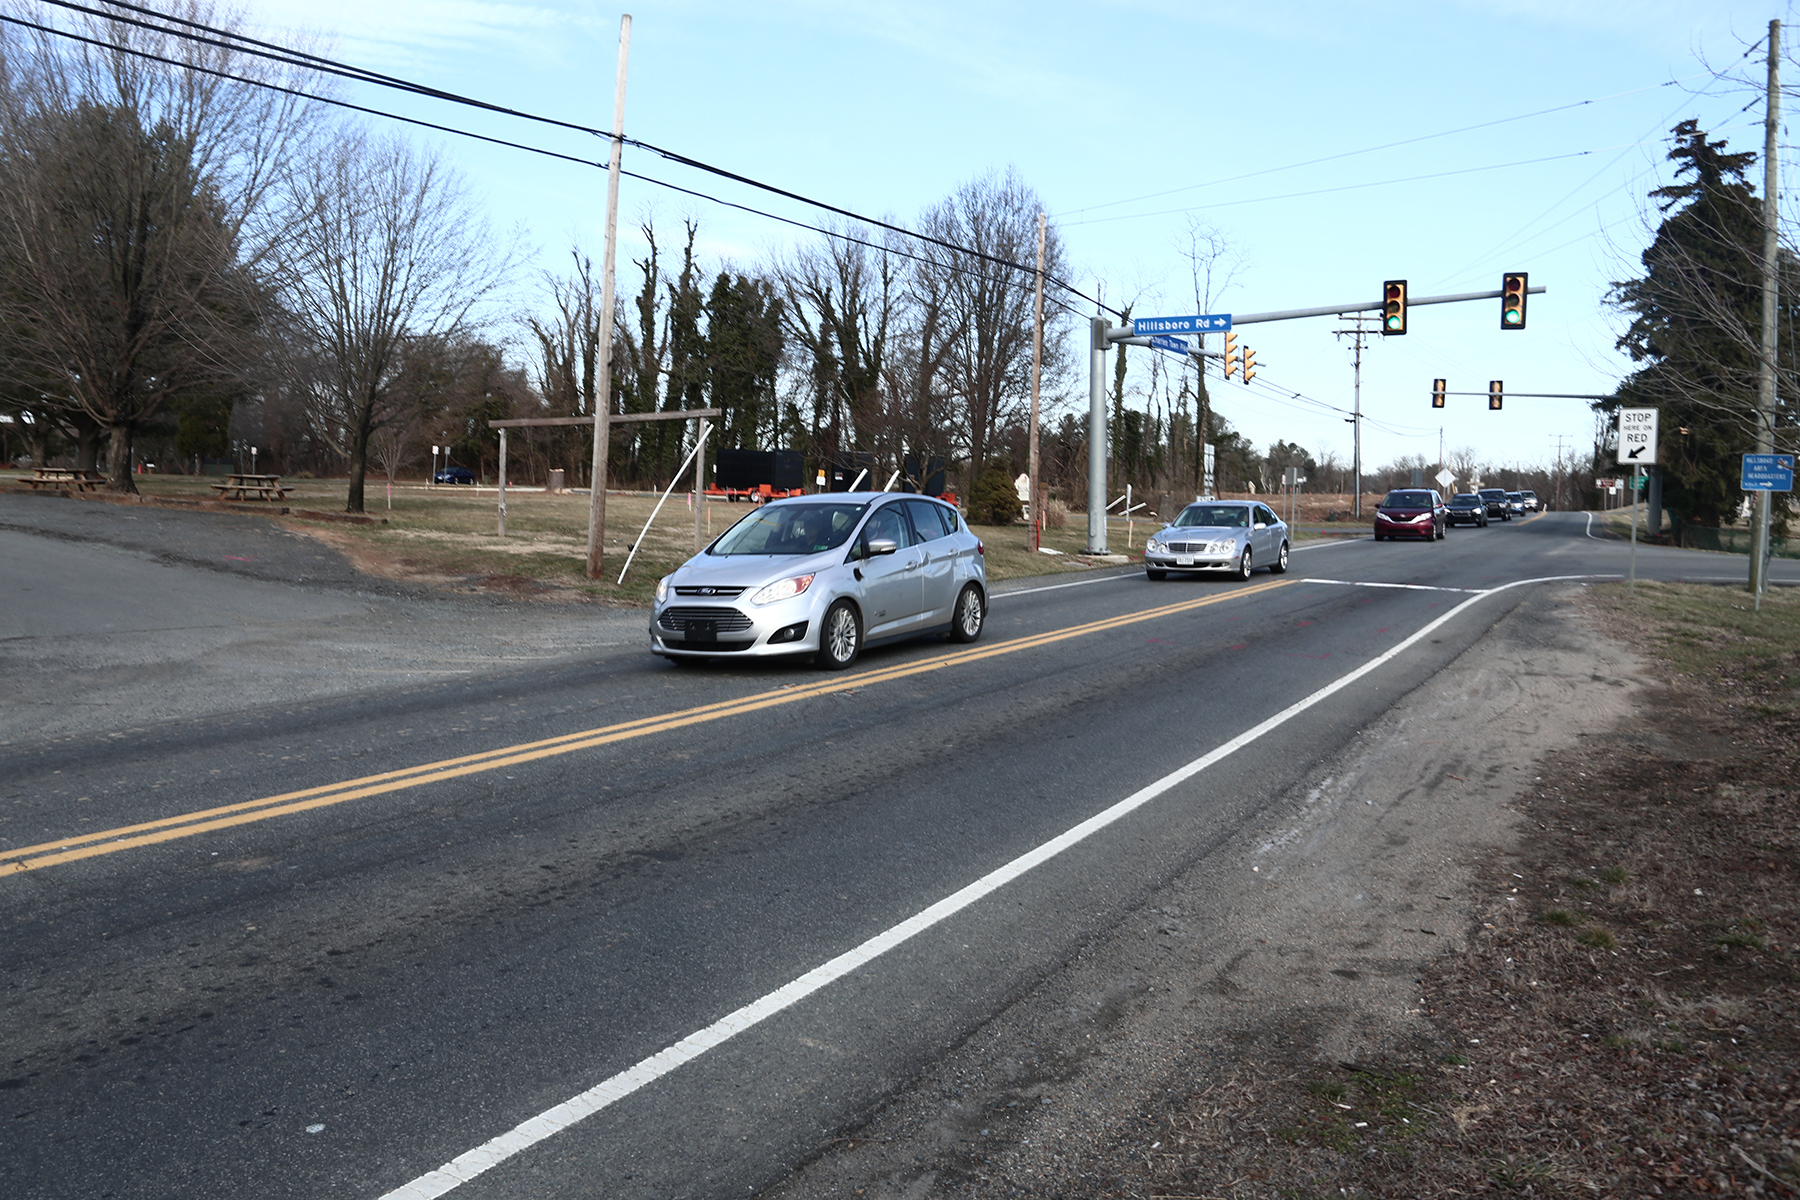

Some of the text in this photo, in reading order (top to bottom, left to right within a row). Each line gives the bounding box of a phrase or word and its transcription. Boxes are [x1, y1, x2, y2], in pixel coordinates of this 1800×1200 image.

[1138, 318, 1210, 331] Hillsboro Rd
[1625, 413, 1652, 423] STOP
[1627, 433, 1648, 443] RED
